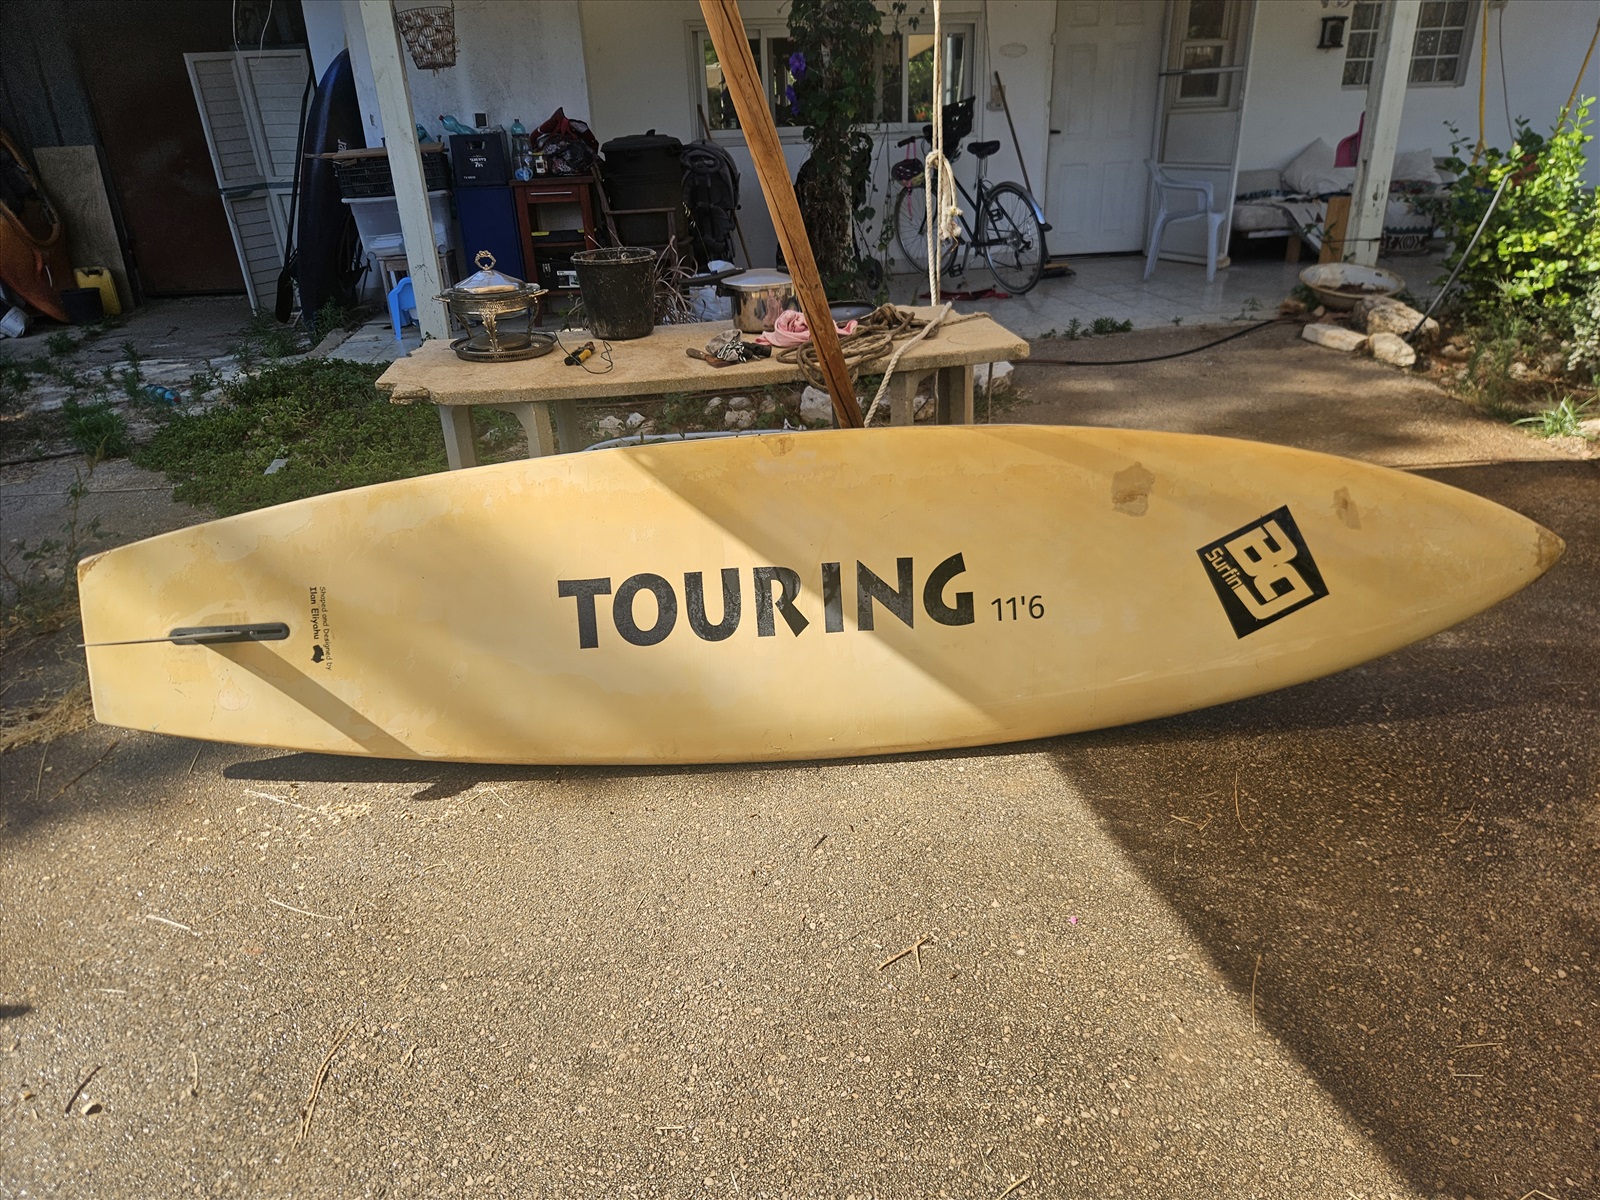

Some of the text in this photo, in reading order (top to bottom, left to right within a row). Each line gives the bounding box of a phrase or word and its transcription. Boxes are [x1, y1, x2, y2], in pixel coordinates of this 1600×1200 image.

[309, 586, 321, 640] Ilan Eliyahu
[319, 586, 333, 671] Shaped and Designed by
[558, 552, 1045, 649] TOURING 11'6
